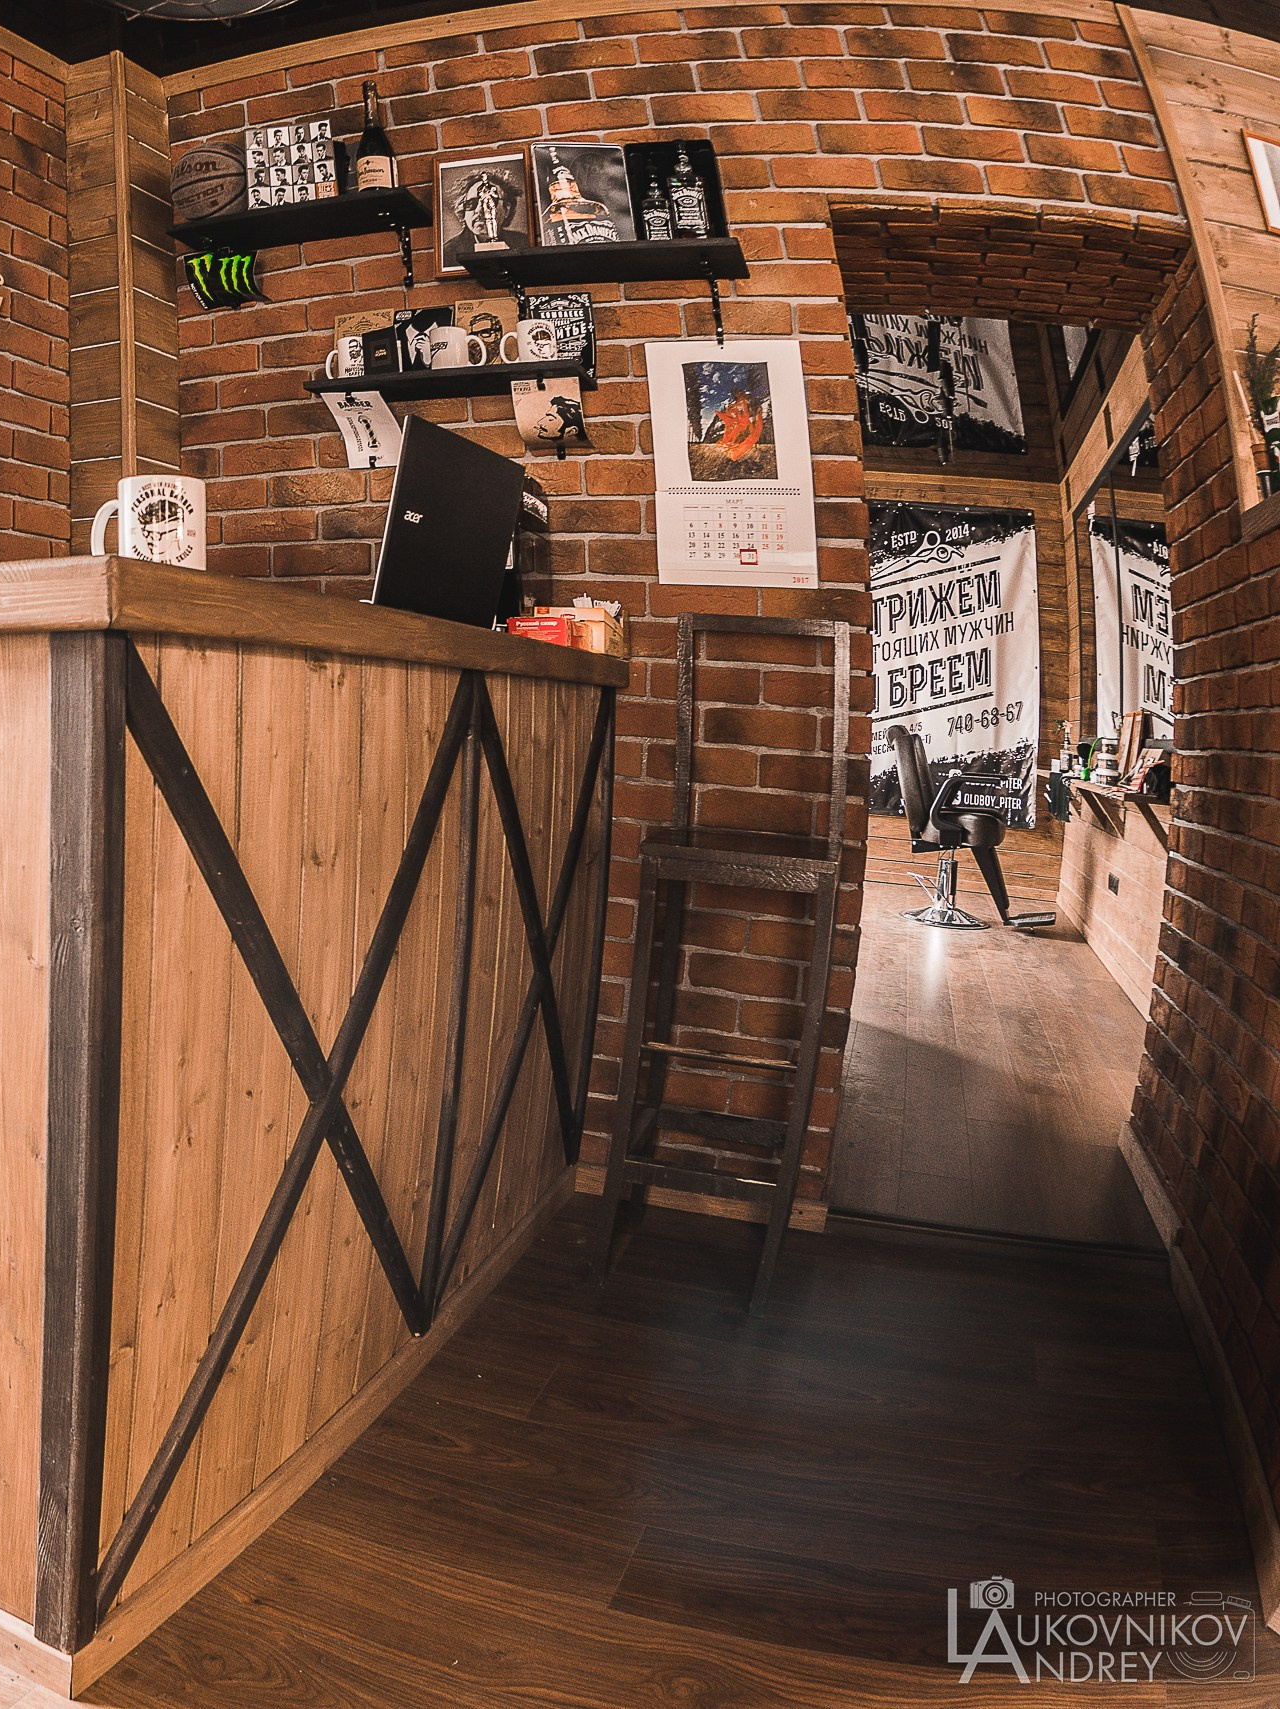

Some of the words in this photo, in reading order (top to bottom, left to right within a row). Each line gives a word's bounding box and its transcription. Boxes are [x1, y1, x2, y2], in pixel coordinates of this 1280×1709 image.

[556, 322, 586, 340] ИТЬЕ
[131, 488, 166, 513] PERSONAL
[404, 510, 424, 524] acer
[945, 524, 970, 542] 2014
[872, 569, 1001, 638] ТРИЖЁМ
[872, 629, 940, 664] ТОЯЩИХ
[943, 611, 1014, 647] МУЖЧИН
[887, 648, 991, 710] БРЕЕМ
[909, 721, 923, 733] 4/5
[946, 701, 1024, 738] 740-68-67
[963, 793, 1022, 810] OLDBOY_PITER
